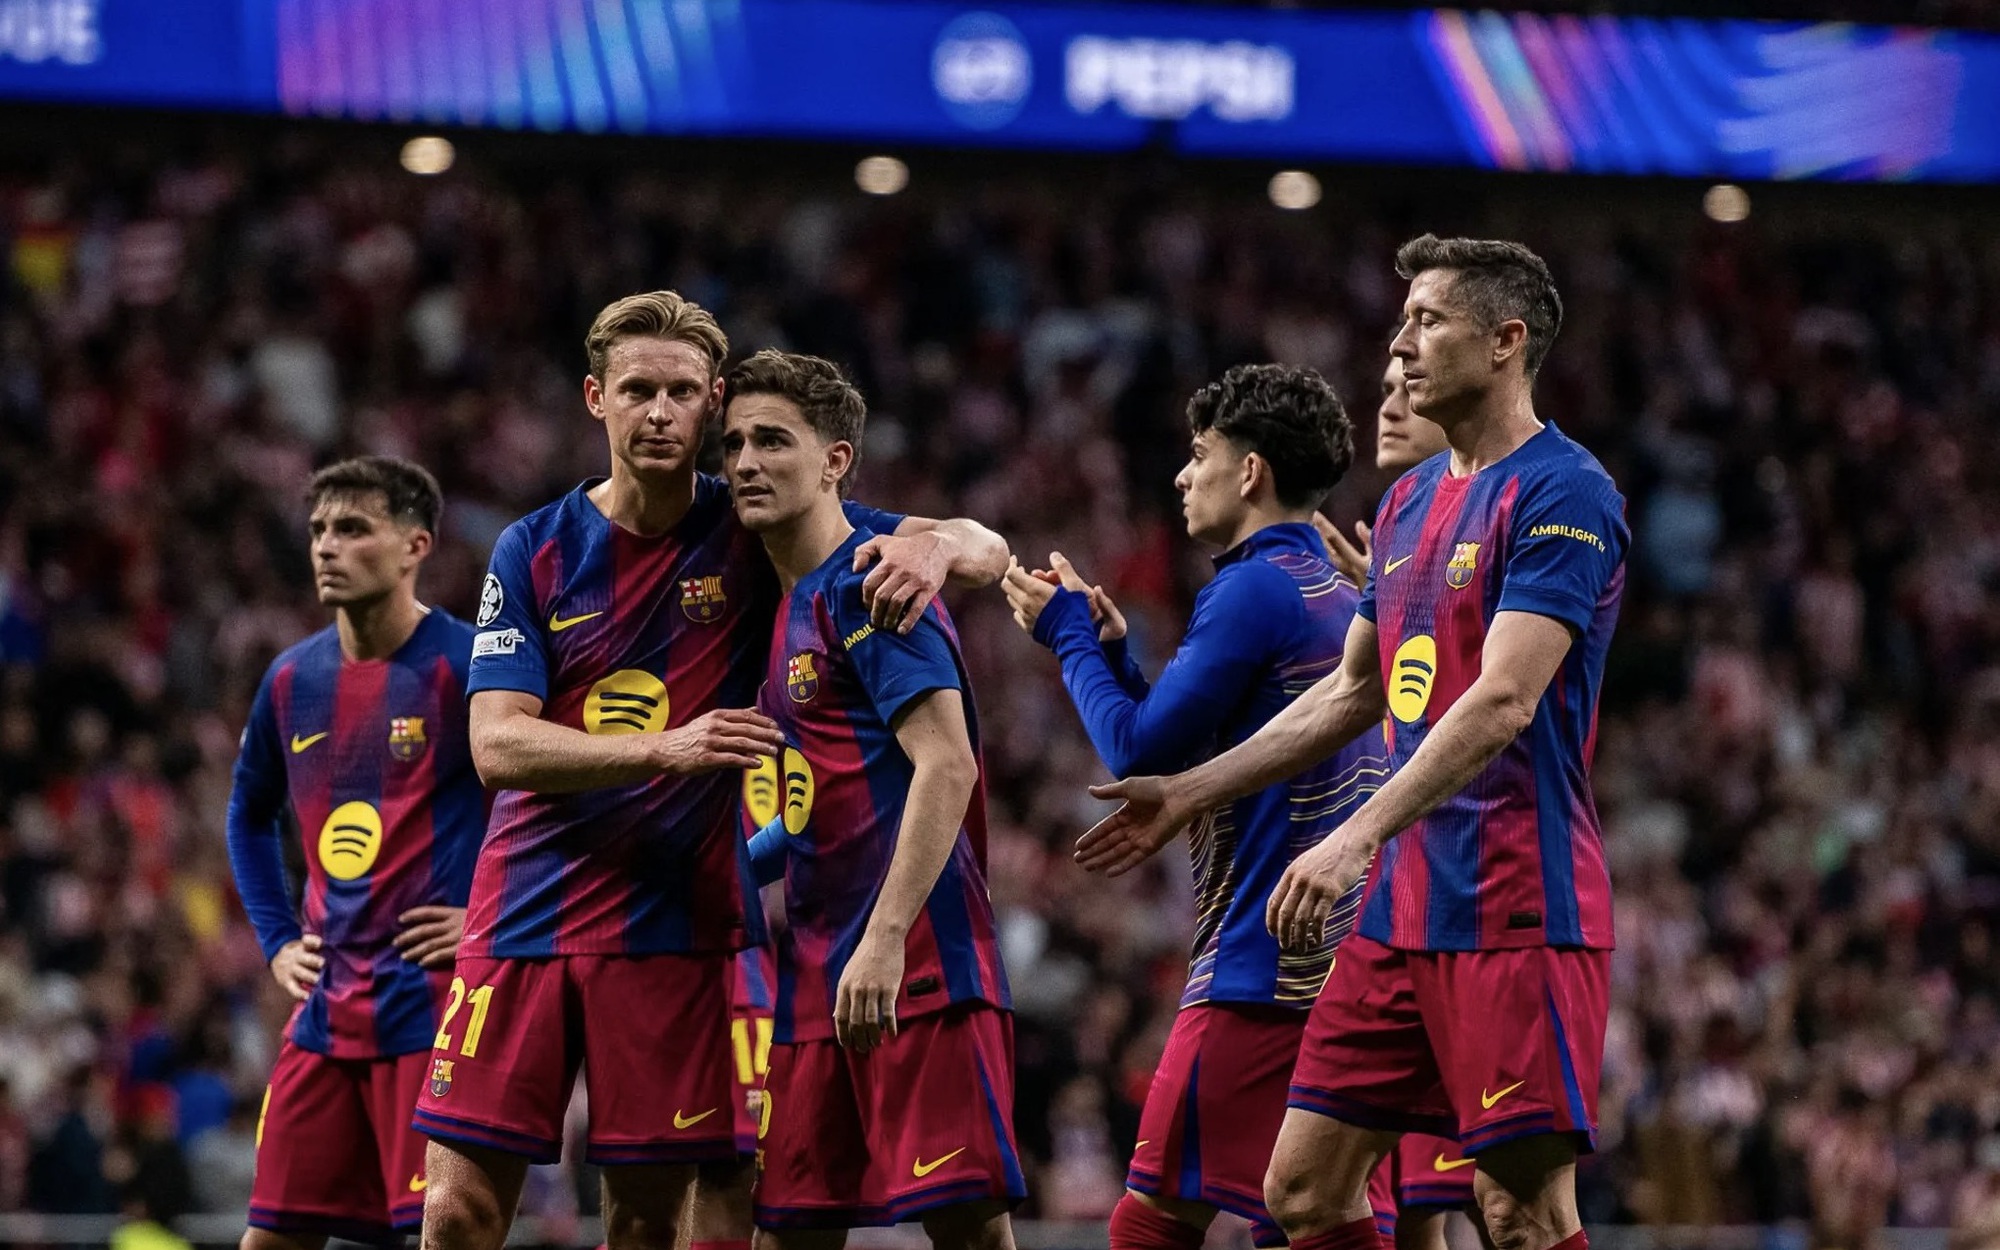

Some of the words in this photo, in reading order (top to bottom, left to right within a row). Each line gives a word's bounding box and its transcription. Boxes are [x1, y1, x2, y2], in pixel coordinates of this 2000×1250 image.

[1067, 37, 1294, 119] PEPSI
[1530, 525, 1599, 546] AMBILIGHT
[843, 623, 876, 651] AMBIL
[433, 976, 495, 1058] 21
